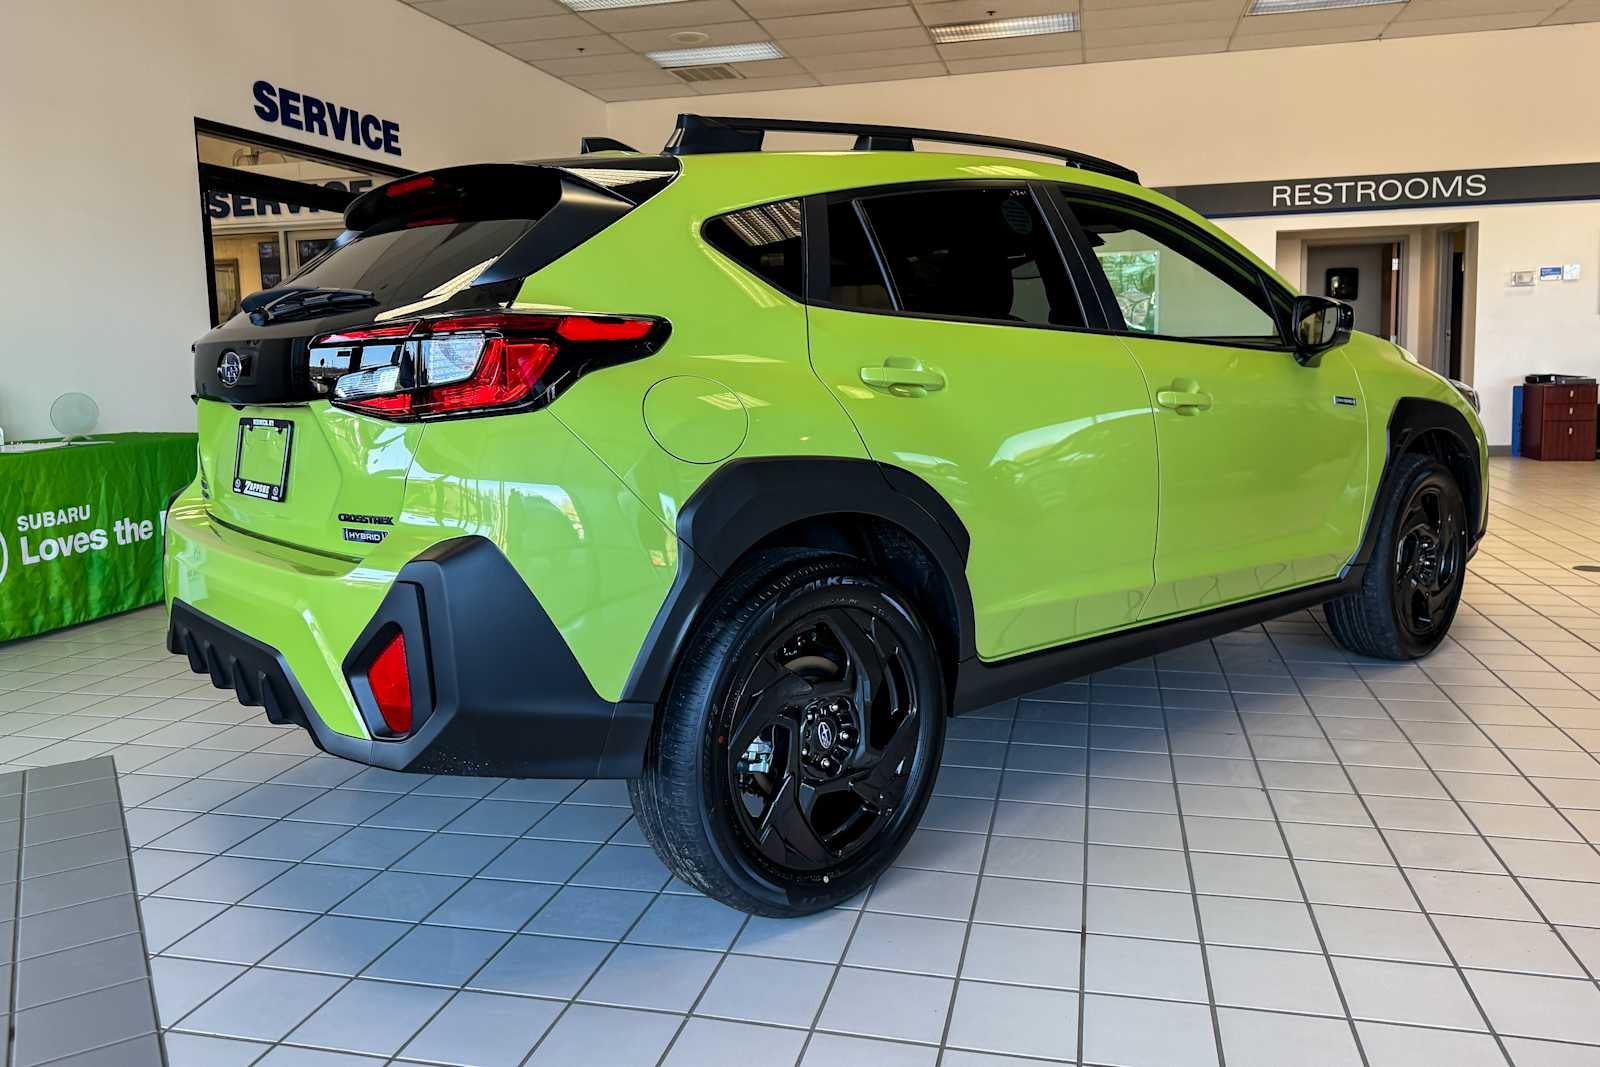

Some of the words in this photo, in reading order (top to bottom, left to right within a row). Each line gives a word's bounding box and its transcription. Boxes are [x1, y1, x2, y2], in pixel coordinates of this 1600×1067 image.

[252, 80, 402, 156] SERVICE
[1272, 174, 1487, 207] RESTROOMS
[17, 505, 91, 532] SUBARU
[20, 528, 109, 566] Loves
[114, 517, 153, 546] the
[349, 531, 381, 541] HYBRID
